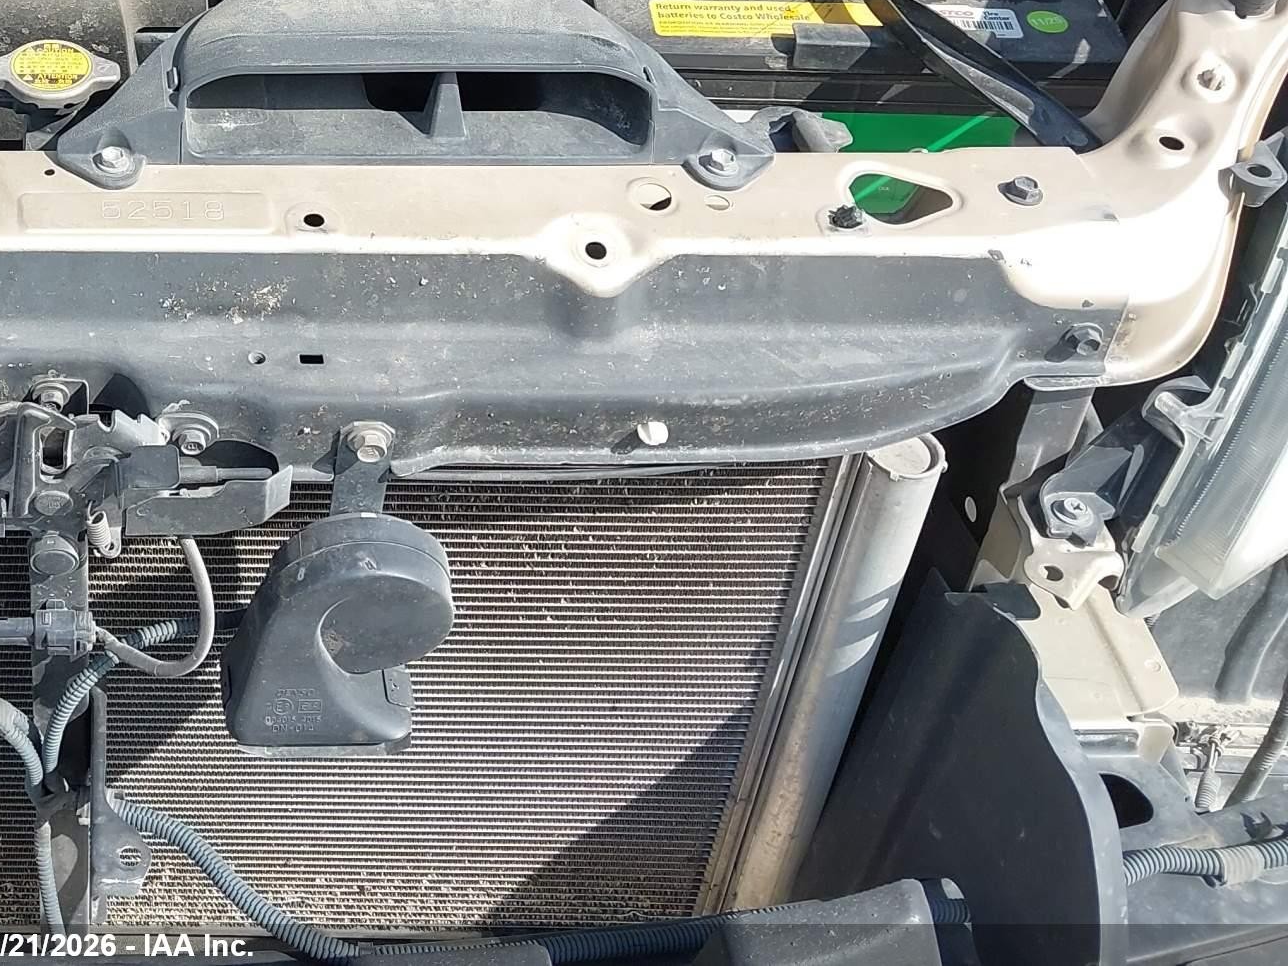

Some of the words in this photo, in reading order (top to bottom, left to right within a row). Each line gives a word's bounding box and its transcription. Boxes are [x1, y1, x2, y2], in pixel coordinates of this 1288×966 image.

[694, 4, 741, 13] warranty
[766, 4, 790, 12] used
[657, 11, 704, 19] batteries
[719, 12, 753, 20] Costco
[755, 12, 810, 21] Wholesale
[101, 200, 224, 221] 52518
